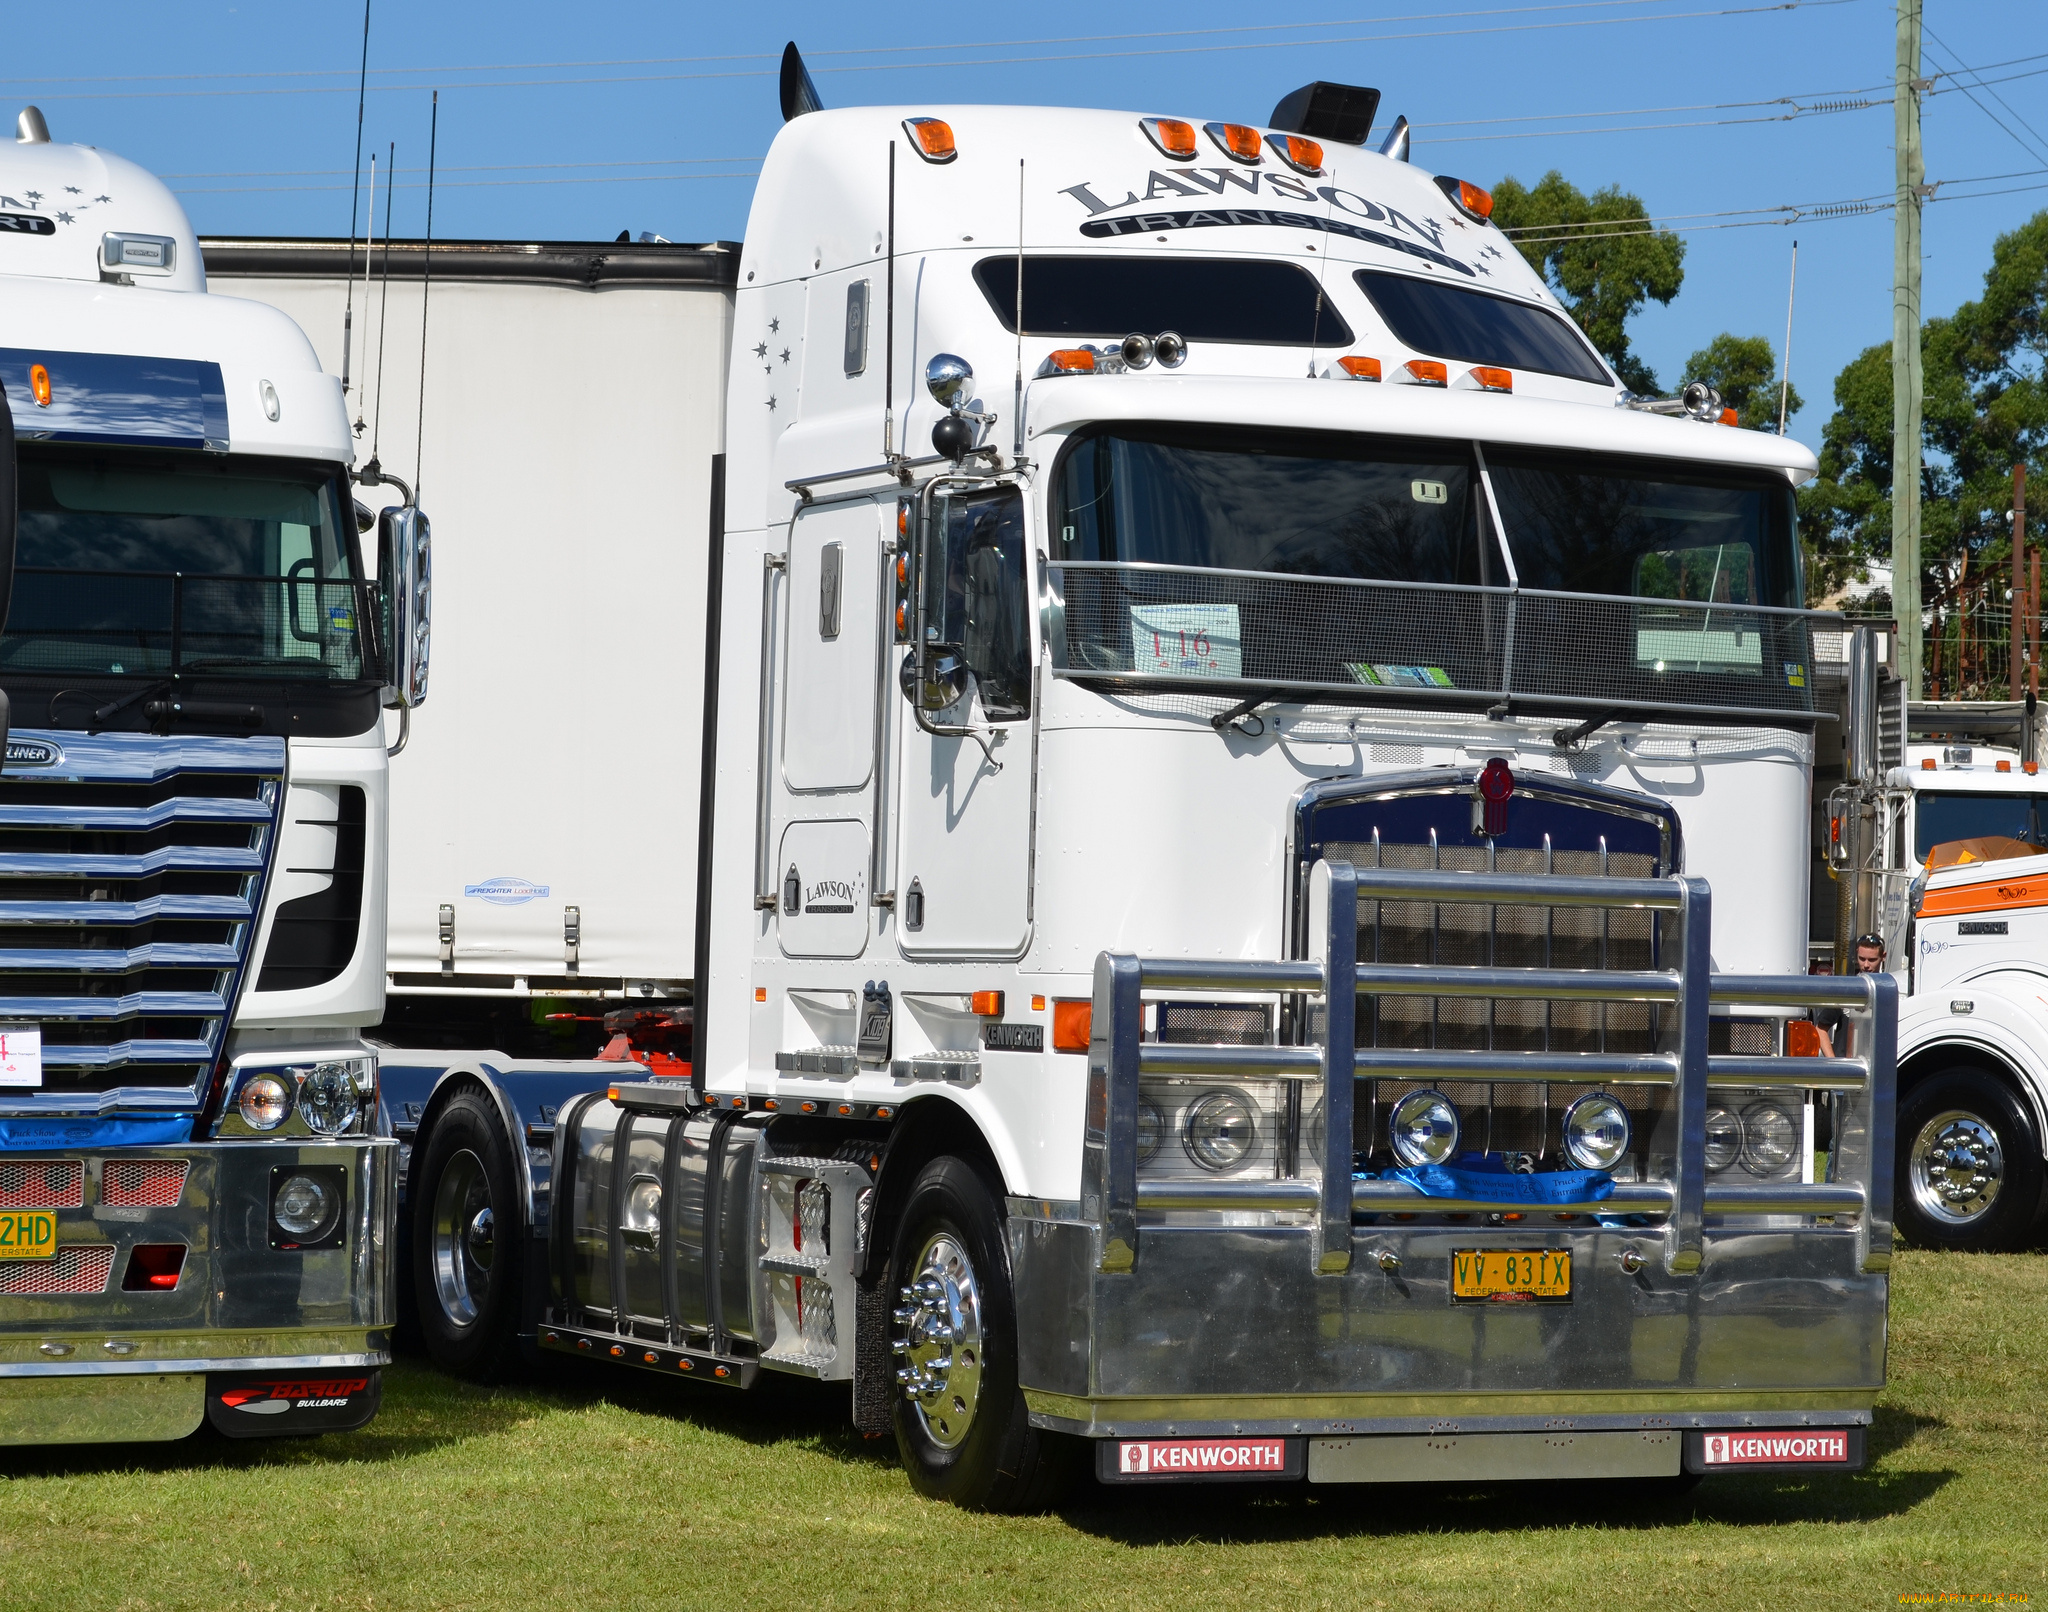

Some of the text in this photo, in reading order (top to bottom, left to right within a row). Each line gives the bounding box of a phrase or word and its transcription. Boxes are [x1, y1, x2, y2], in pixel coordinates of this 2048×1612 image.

[1057, 167, 1446, 253] LAWSON
[1089, 209, 1469, 271] TRANSPORT
[6, 746, 46, 759] LINER
[805, 880, 854, 903] LAWSON
[806, 905, 853, 913] TRANSPORT
[1959, 922, 2008, 932] KENWORTH
[985, 1025, 1043, 1047] KENWORTH
[8, 1128, 31, 1138] Truck
[33, 1128, 57, 1138] Show
[1482, 1179, 1515, 1192] Working
[1553, 1177, 1576, 1187] Truck
[1490, 1189, 1499, 1200] of
[1551, 1187, 1583, 1198] Entrant
[296, 1398, 349, 1408] BULLBARS
[1732, 1437, 1844, 1458] KENWORTH
[1153, 1445, 1280, 1468] KENWORTH
